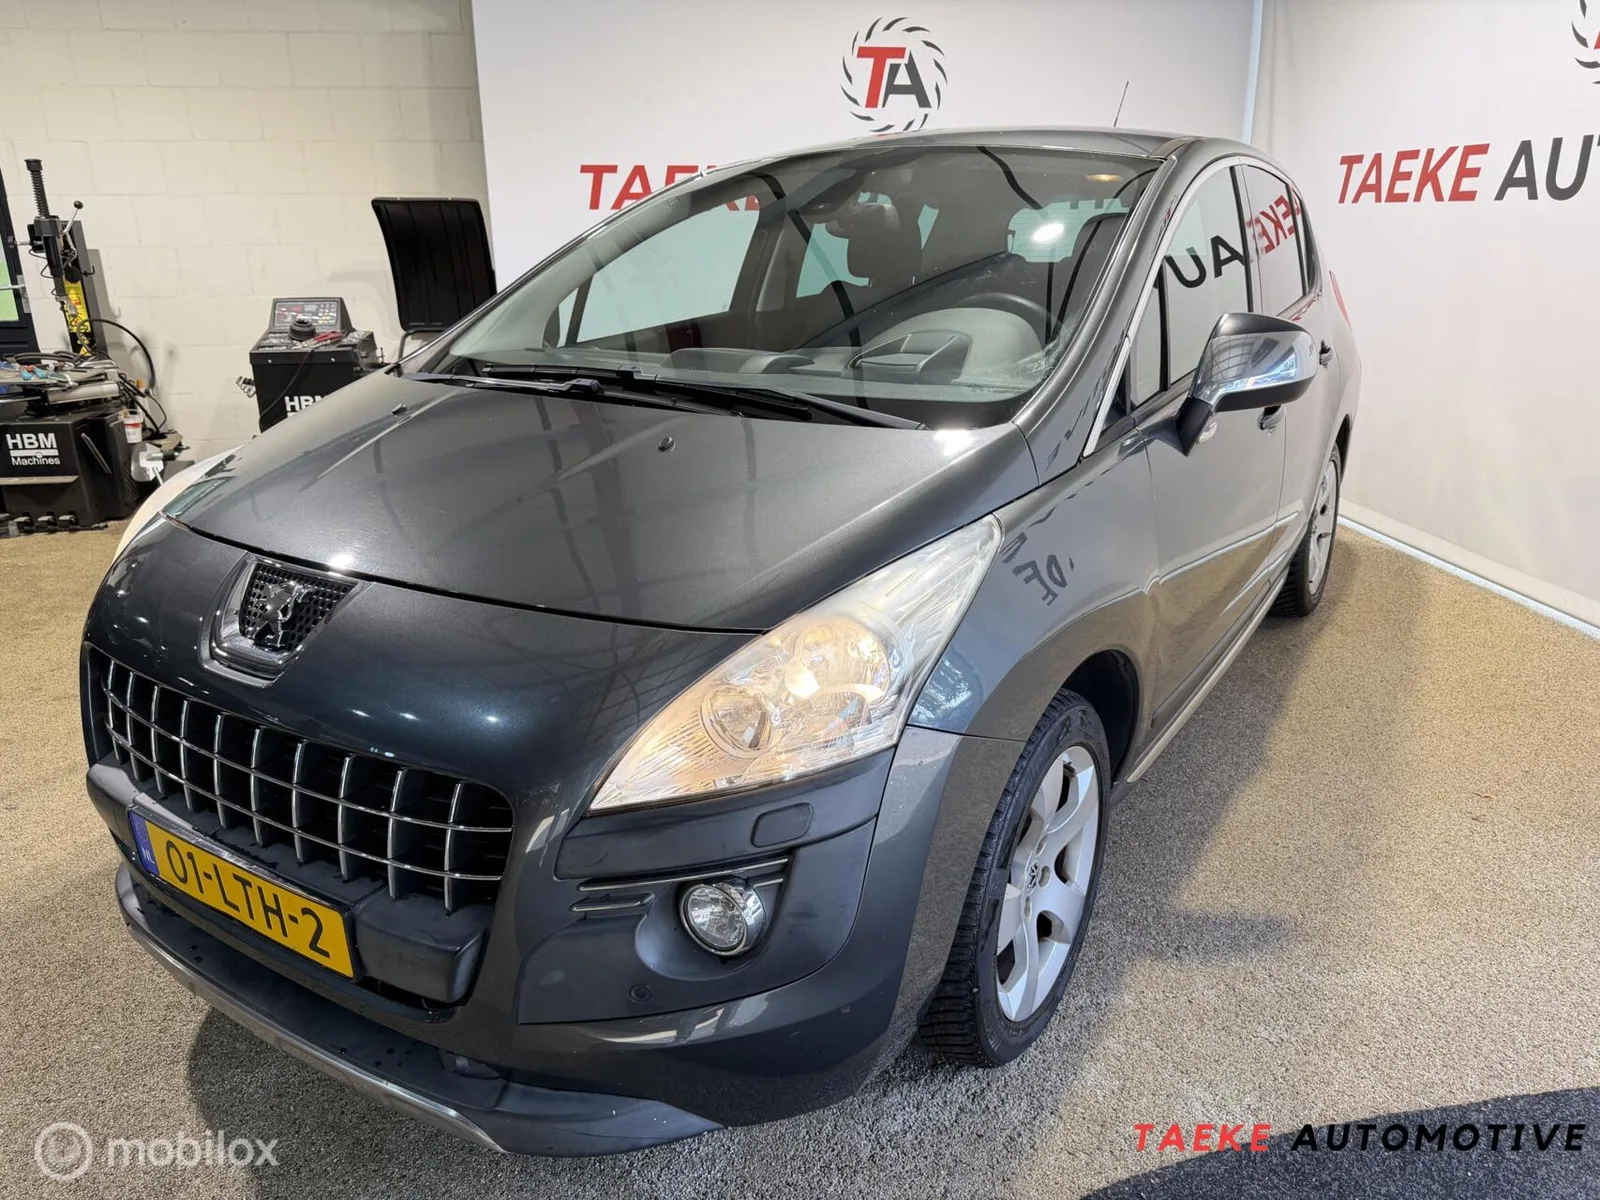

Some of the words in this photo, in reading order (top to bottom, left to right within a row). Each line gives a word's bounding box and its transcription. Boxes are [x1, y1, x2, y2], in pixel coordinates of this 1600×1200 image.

[856, 46, 932, 109] TA
[1337, 143, 1490, 205] TAEKE
[1494, 134, 1600, 201] AU
[284, 395, 325, 412] HB
[5, 433, 57, 449] HBM
[11, 456, 61, 466] Machines
[142, 848, 156, 864] NL
[165, 840, 331, 959] 01-LTH-2
